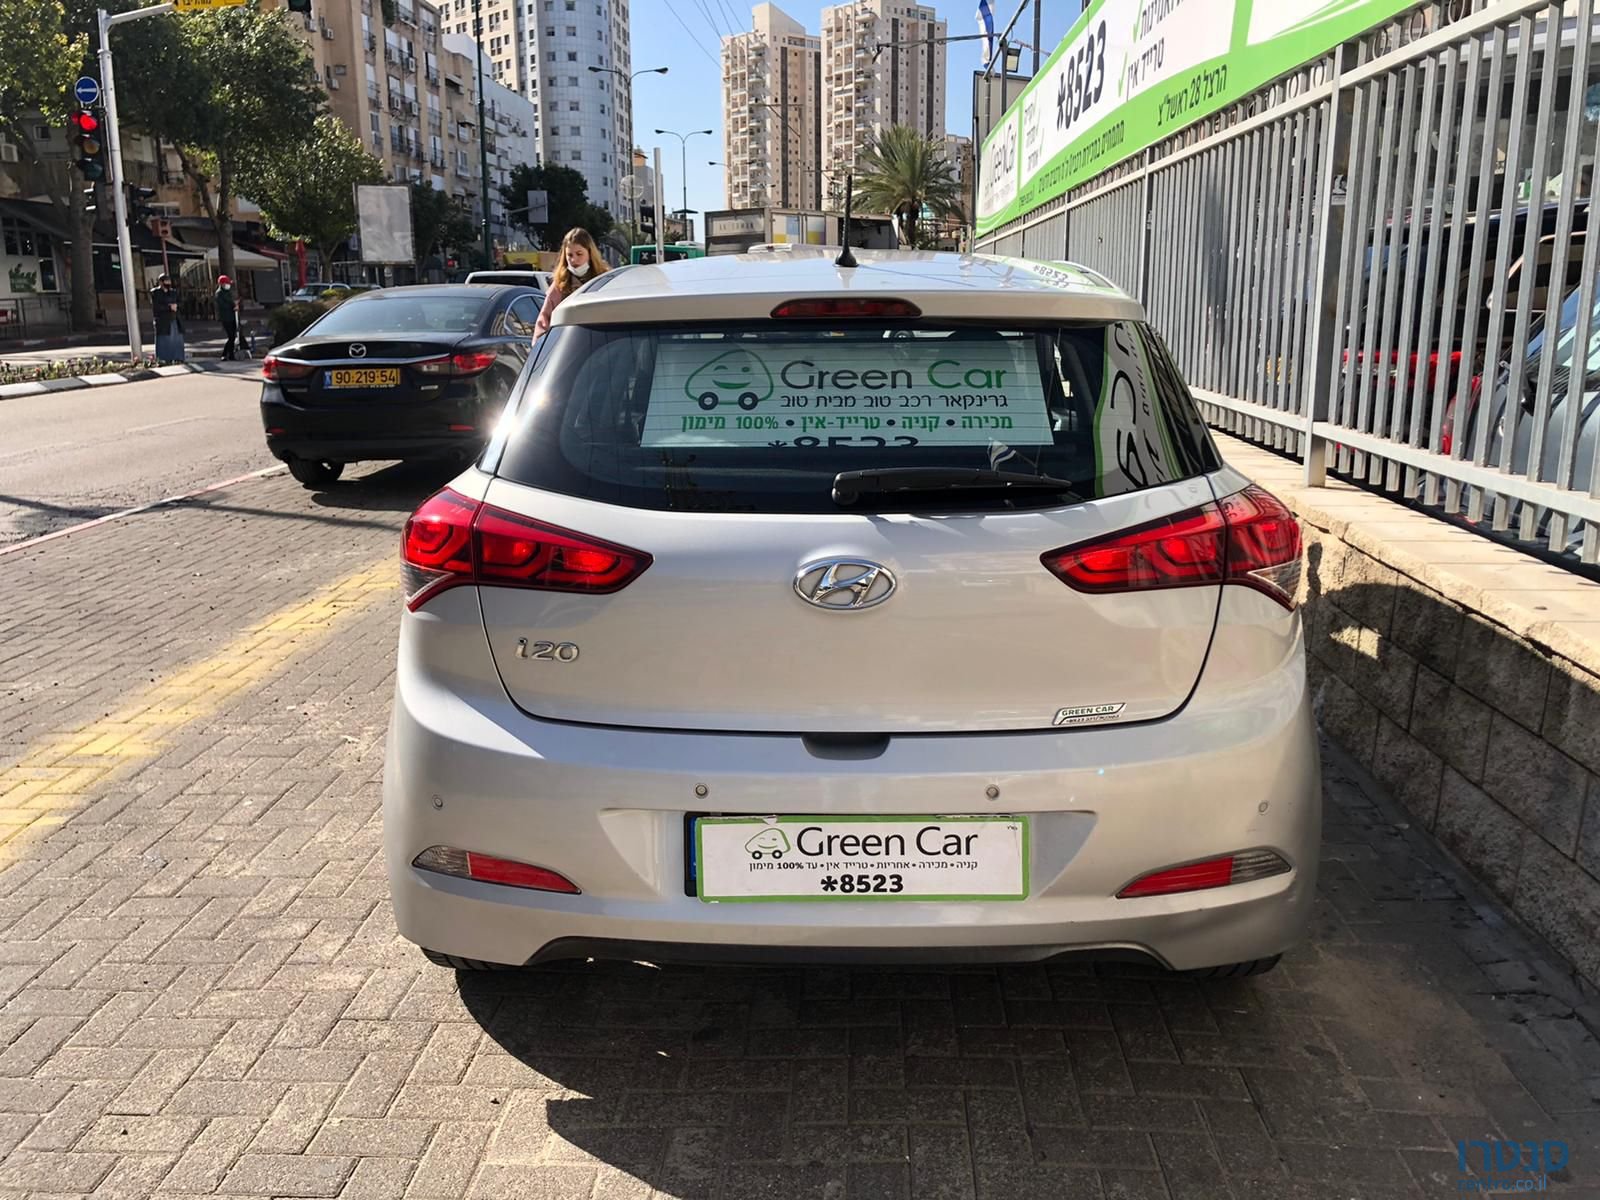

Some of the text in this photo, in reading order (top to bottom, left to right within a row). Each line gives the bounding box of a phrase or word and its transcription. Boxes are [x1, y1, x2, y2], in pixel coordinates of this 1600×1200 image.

[1126, 37, 1165, 103] טרייד אין
[1203, 64, 1227, 101] הרצל
[1189, 75, 1202, 110] 28
[781, 359, 1008, 390] Green Car
[780, 394, 1008, 410] גרינקאר רכב טוב מבית טוב
[681, 415, 1013, 432] מכירה קניה טרייד-אין 100% מימון
[515, 636, 579, 663] i20
[1061, 705, 1114, 717] GREEN CAR
[796, 826, 978, 857] Green Car
[749, 862, 774, 872] מימון
[806, 861, 818, 869] עד
[826, 861, 840, 871] אין
[842, 861, 868, 869] טרייד
[876, 861, 910, 869] אחריות
[919, 861, 948, 869] מכירה
[956, 861, 978, 871] קניה
